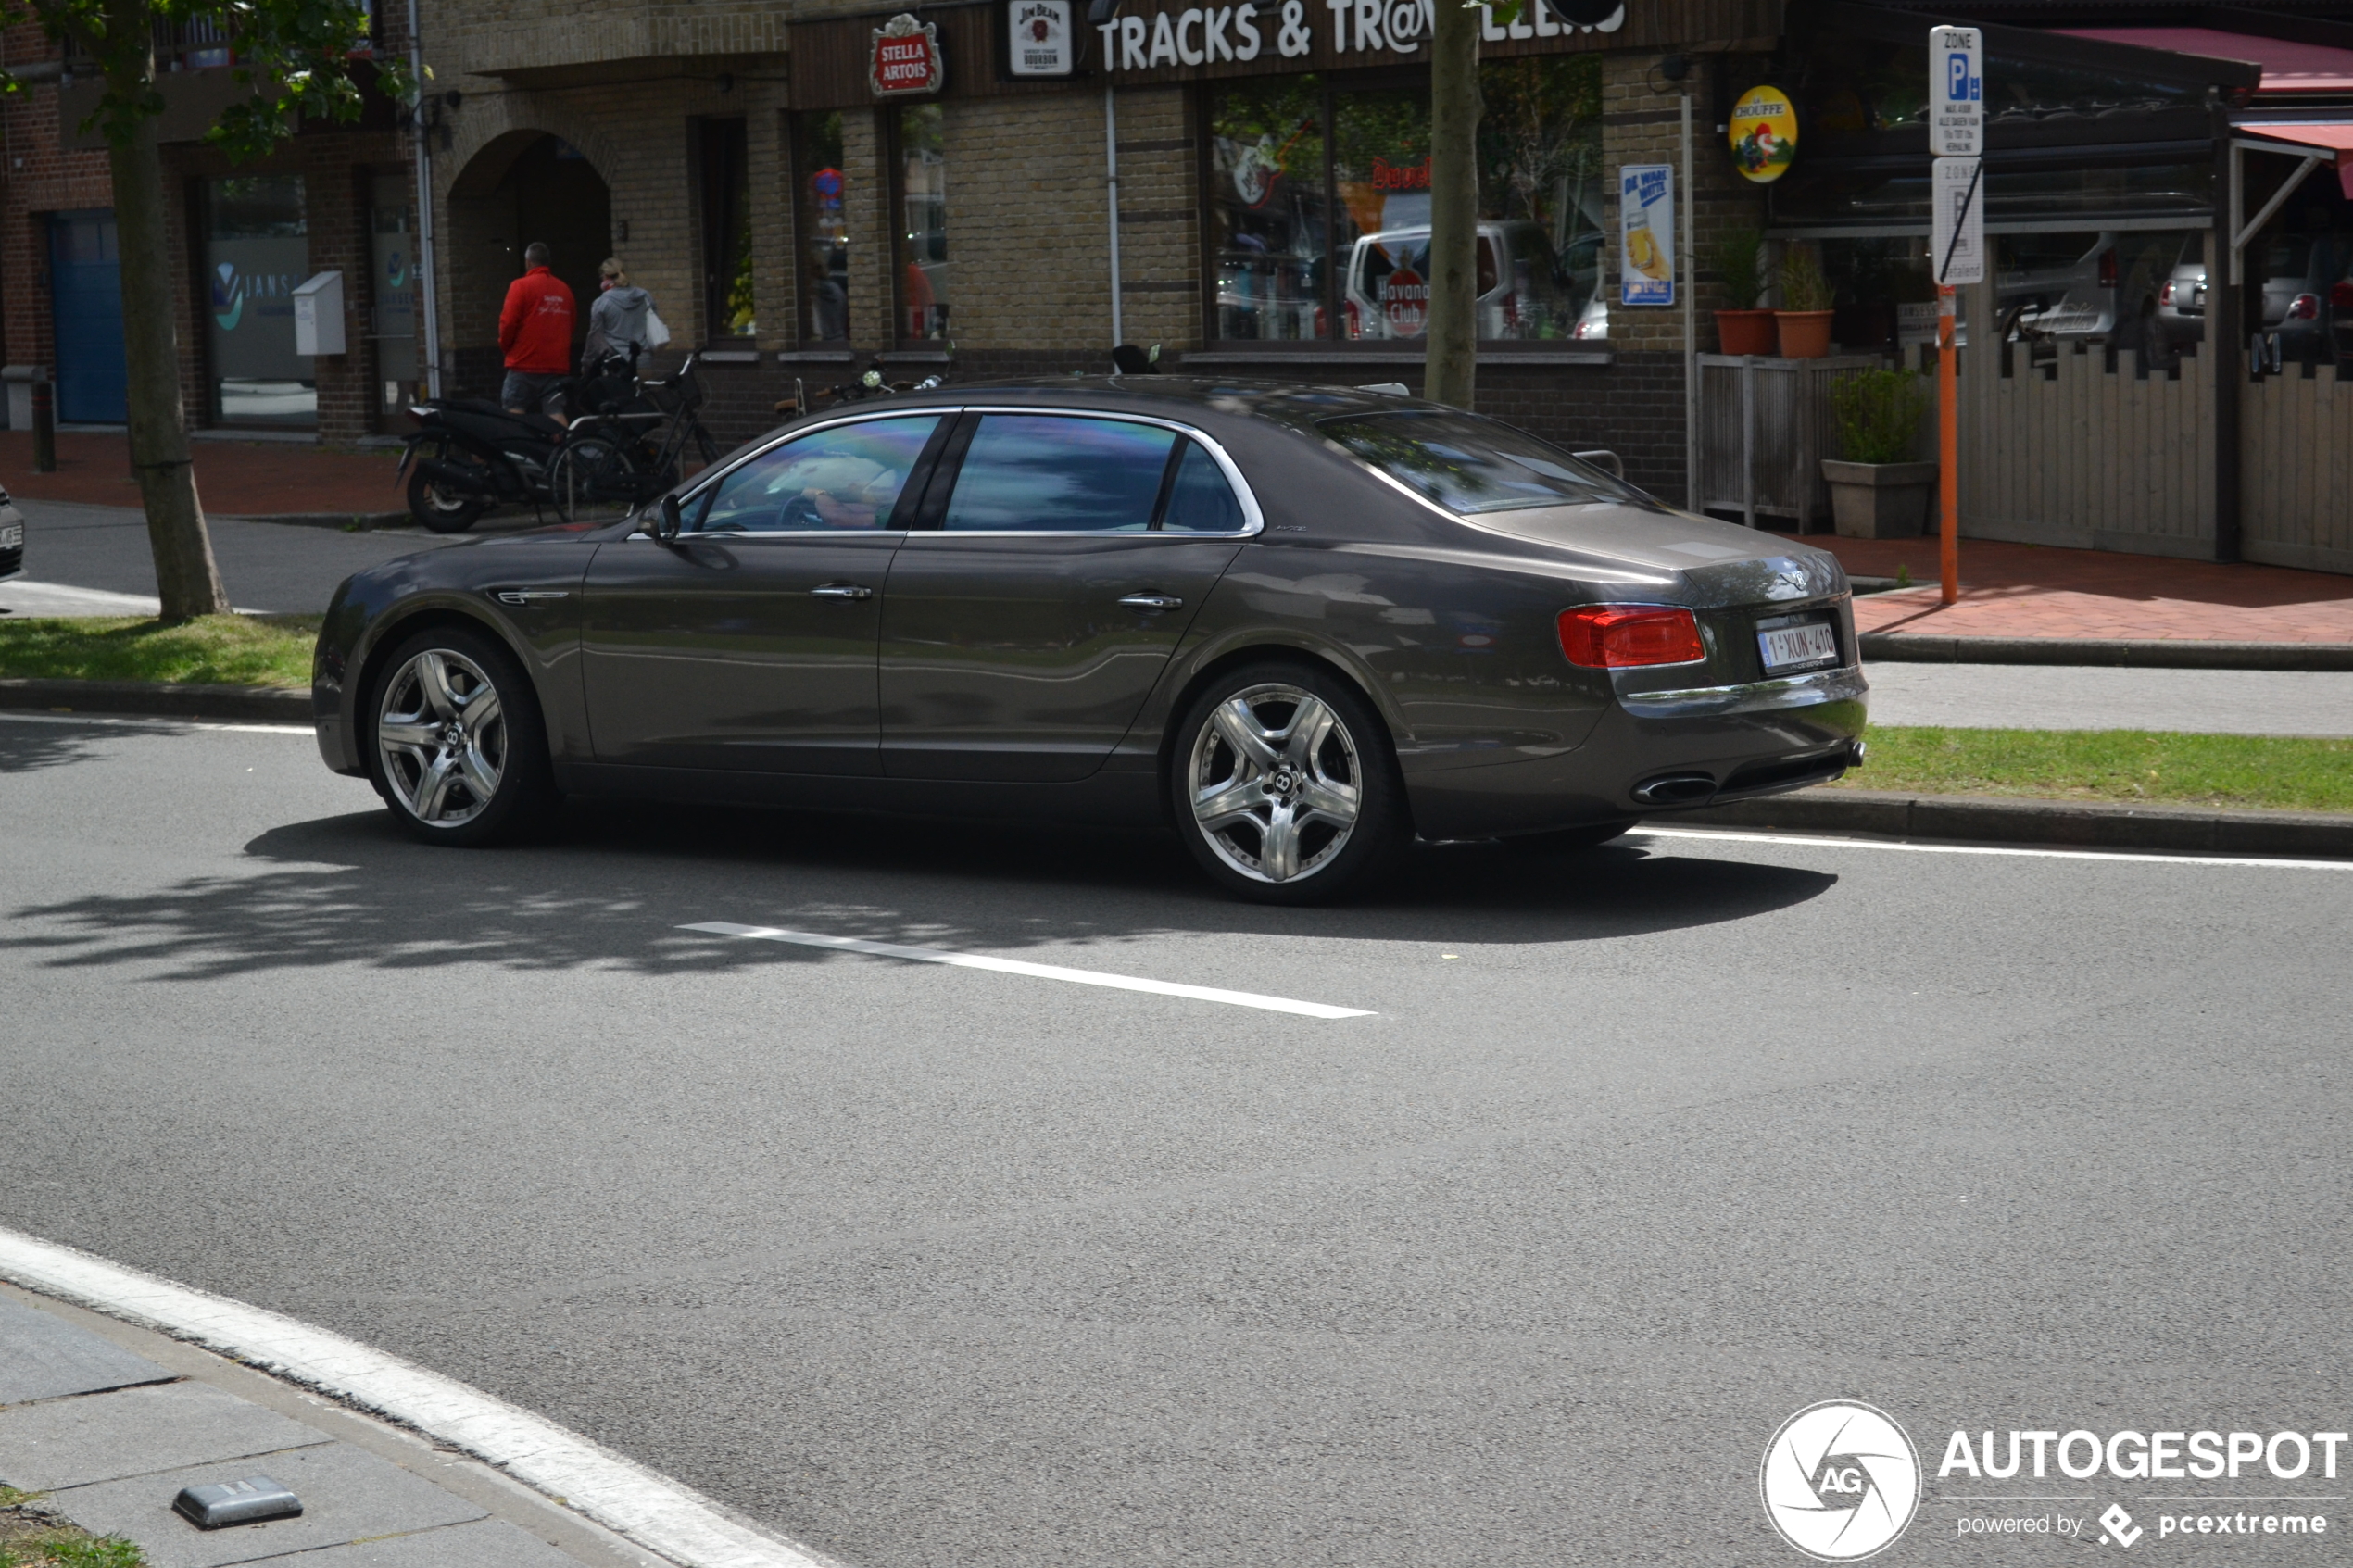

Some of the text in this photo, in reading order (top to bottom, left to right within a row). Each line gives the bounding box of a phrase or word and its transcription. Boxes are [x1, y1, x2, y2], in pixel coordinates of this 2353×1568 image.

[1097, 3, 1261, 72] TRACKS
[1277, 0, 1311, 57] &
[1944, 32, 1972, 49] ZONE
[882, 44, 925, 62] STELLA
[883, 61, 926, 81] ARTOIS
[1950, 58, 1966, 95] P
[1734, 102, 1784, 119] CHOUFFE
[1945, 165, 1975, 180] ZONE
[1944, 262, 1981, 278] etalend
[1378, 280, 1430, 300] Havana
[1390, 303, 1420, 323] Club
